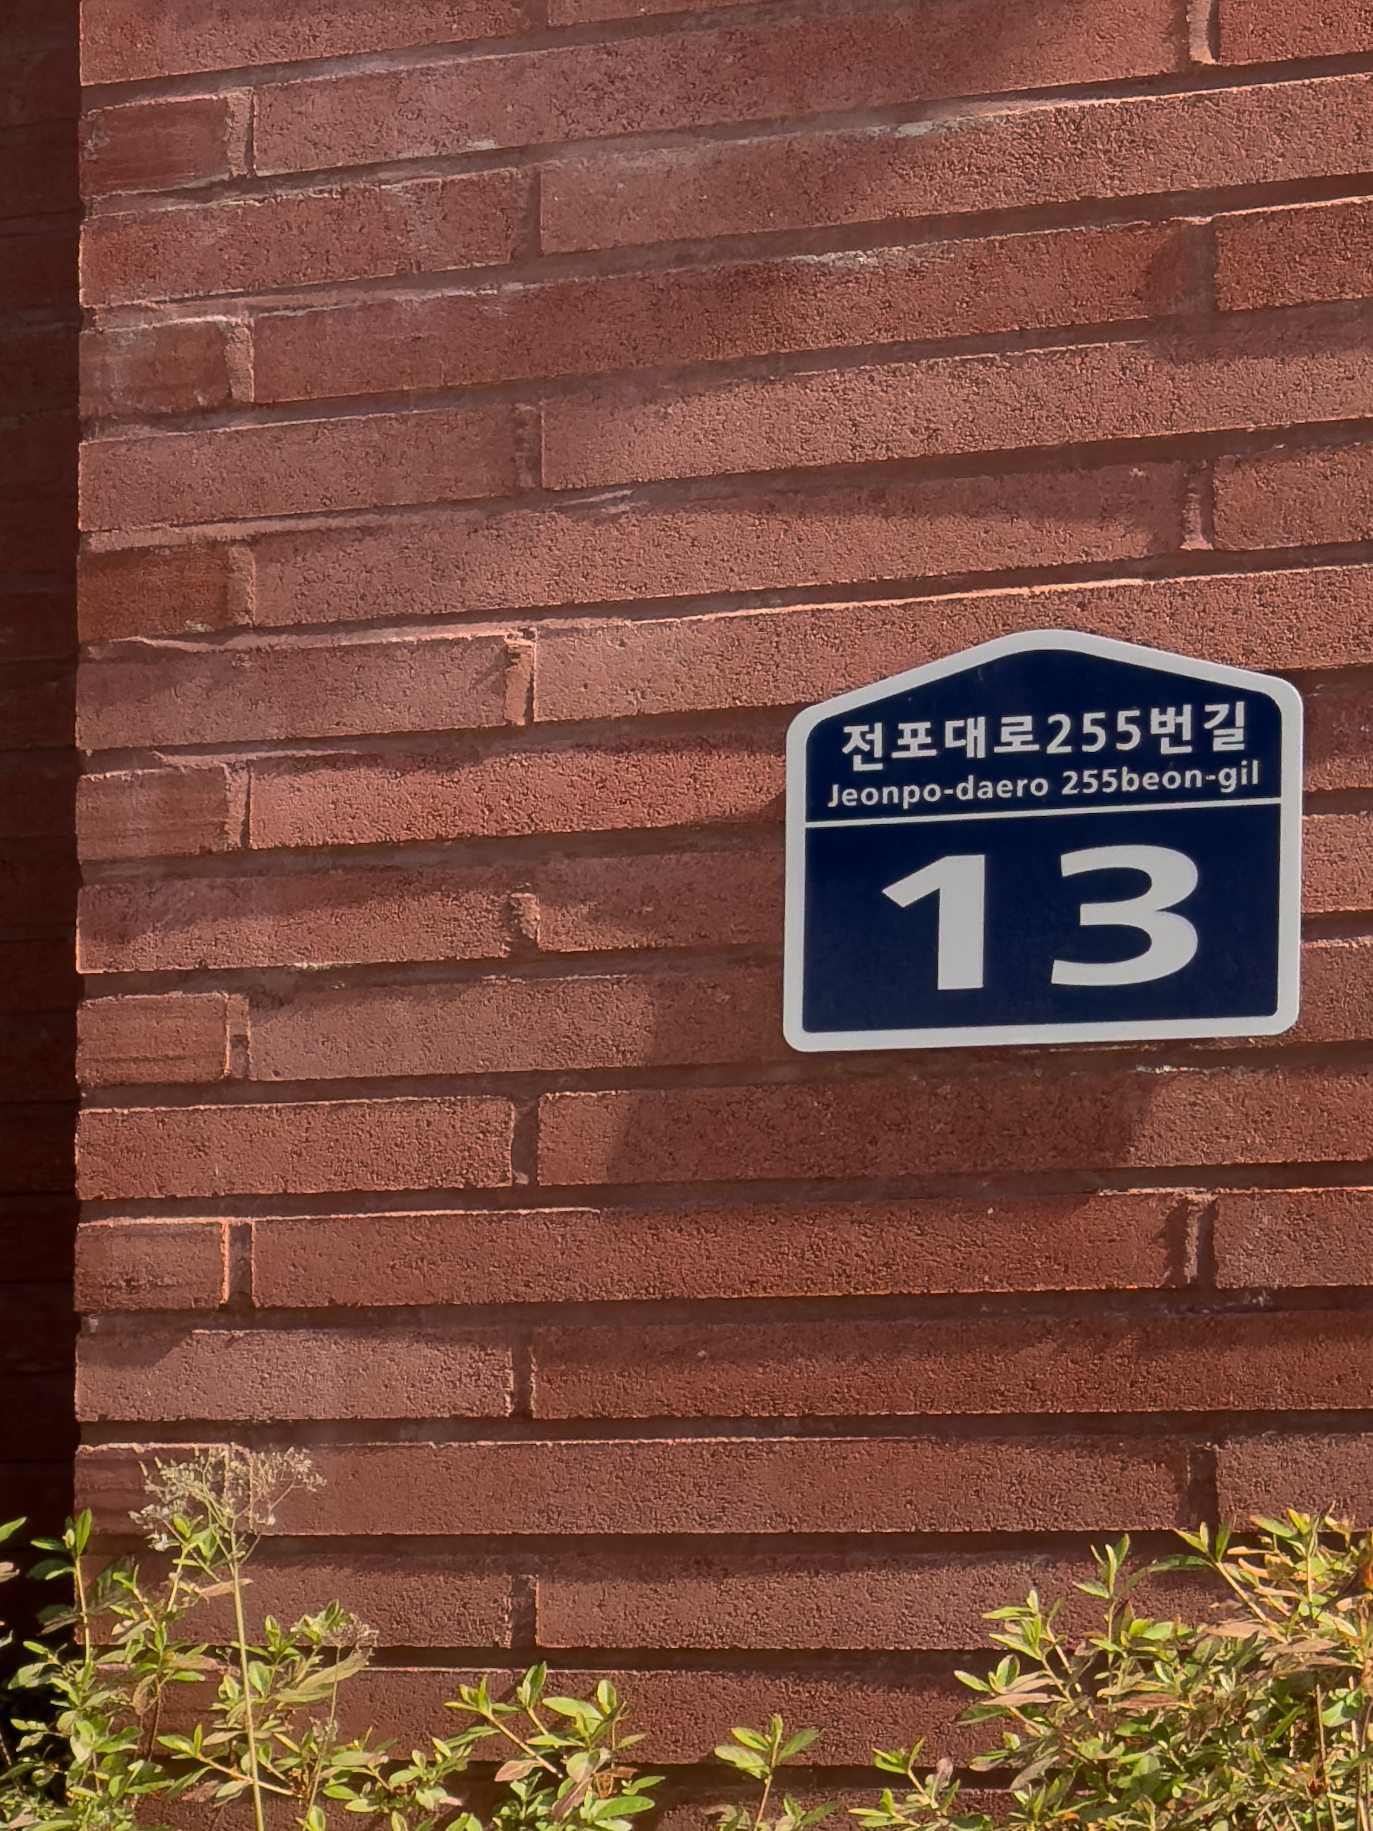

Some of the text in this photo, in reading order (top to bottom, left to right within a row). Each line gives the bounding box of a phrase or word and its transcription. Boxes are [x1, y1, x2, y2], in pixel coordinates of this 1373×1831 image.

[841, 701, 1246, 772] 전포대로255번길
[827, 759, 1260, 809] Jeonpo-daero 255beon-gil
[881, 844, 1199, 991] 13
